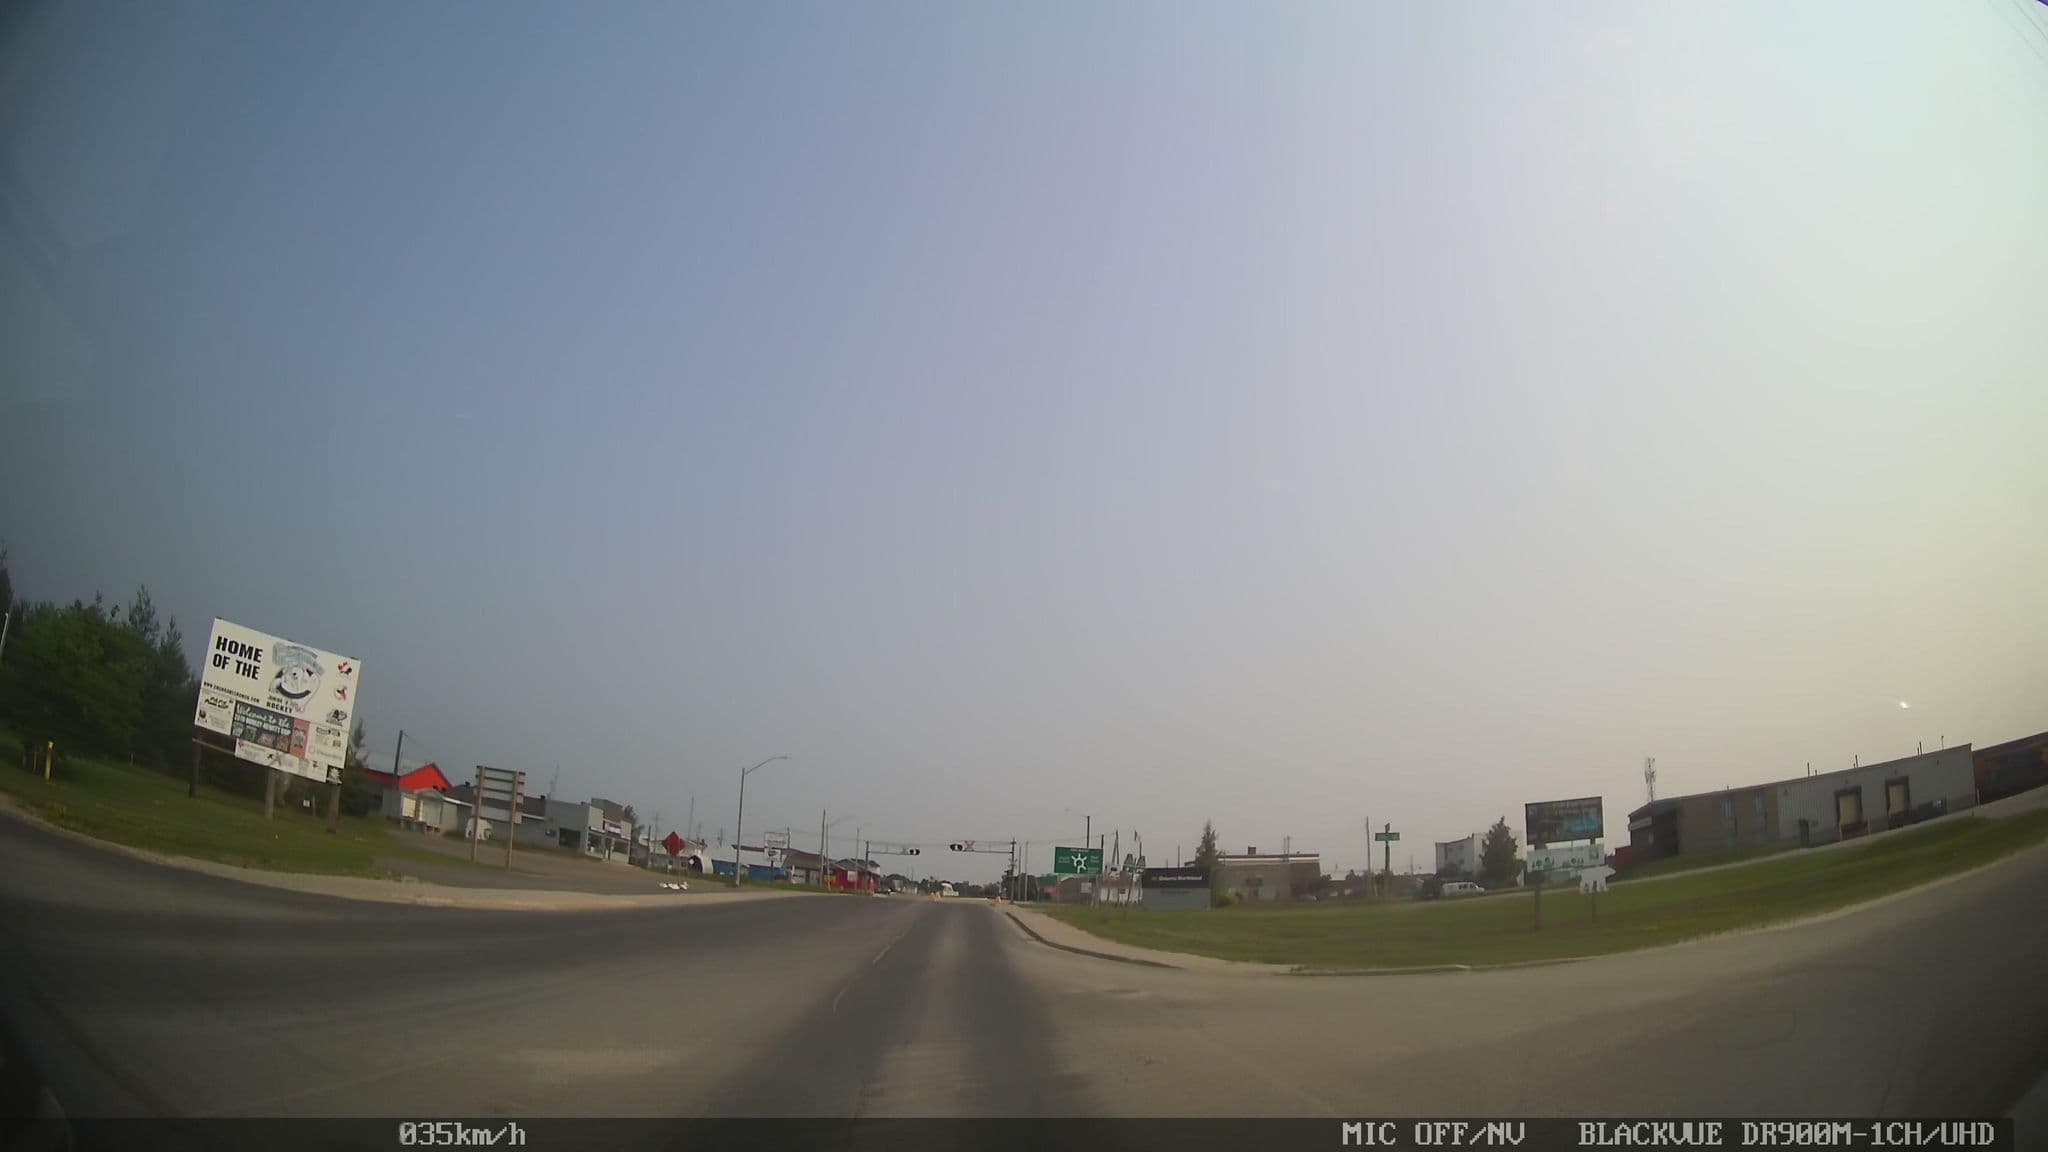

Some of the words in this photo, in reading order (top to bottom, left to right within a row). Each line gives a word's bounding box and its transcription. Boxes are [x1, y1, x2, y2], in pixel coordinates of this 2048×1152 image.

[215, 635, 263, 663] HOME
[212, 653, 231, 670] OF
[235, 660, 261, 680] THE
[266, 701, 293, 714] HOCKEY
